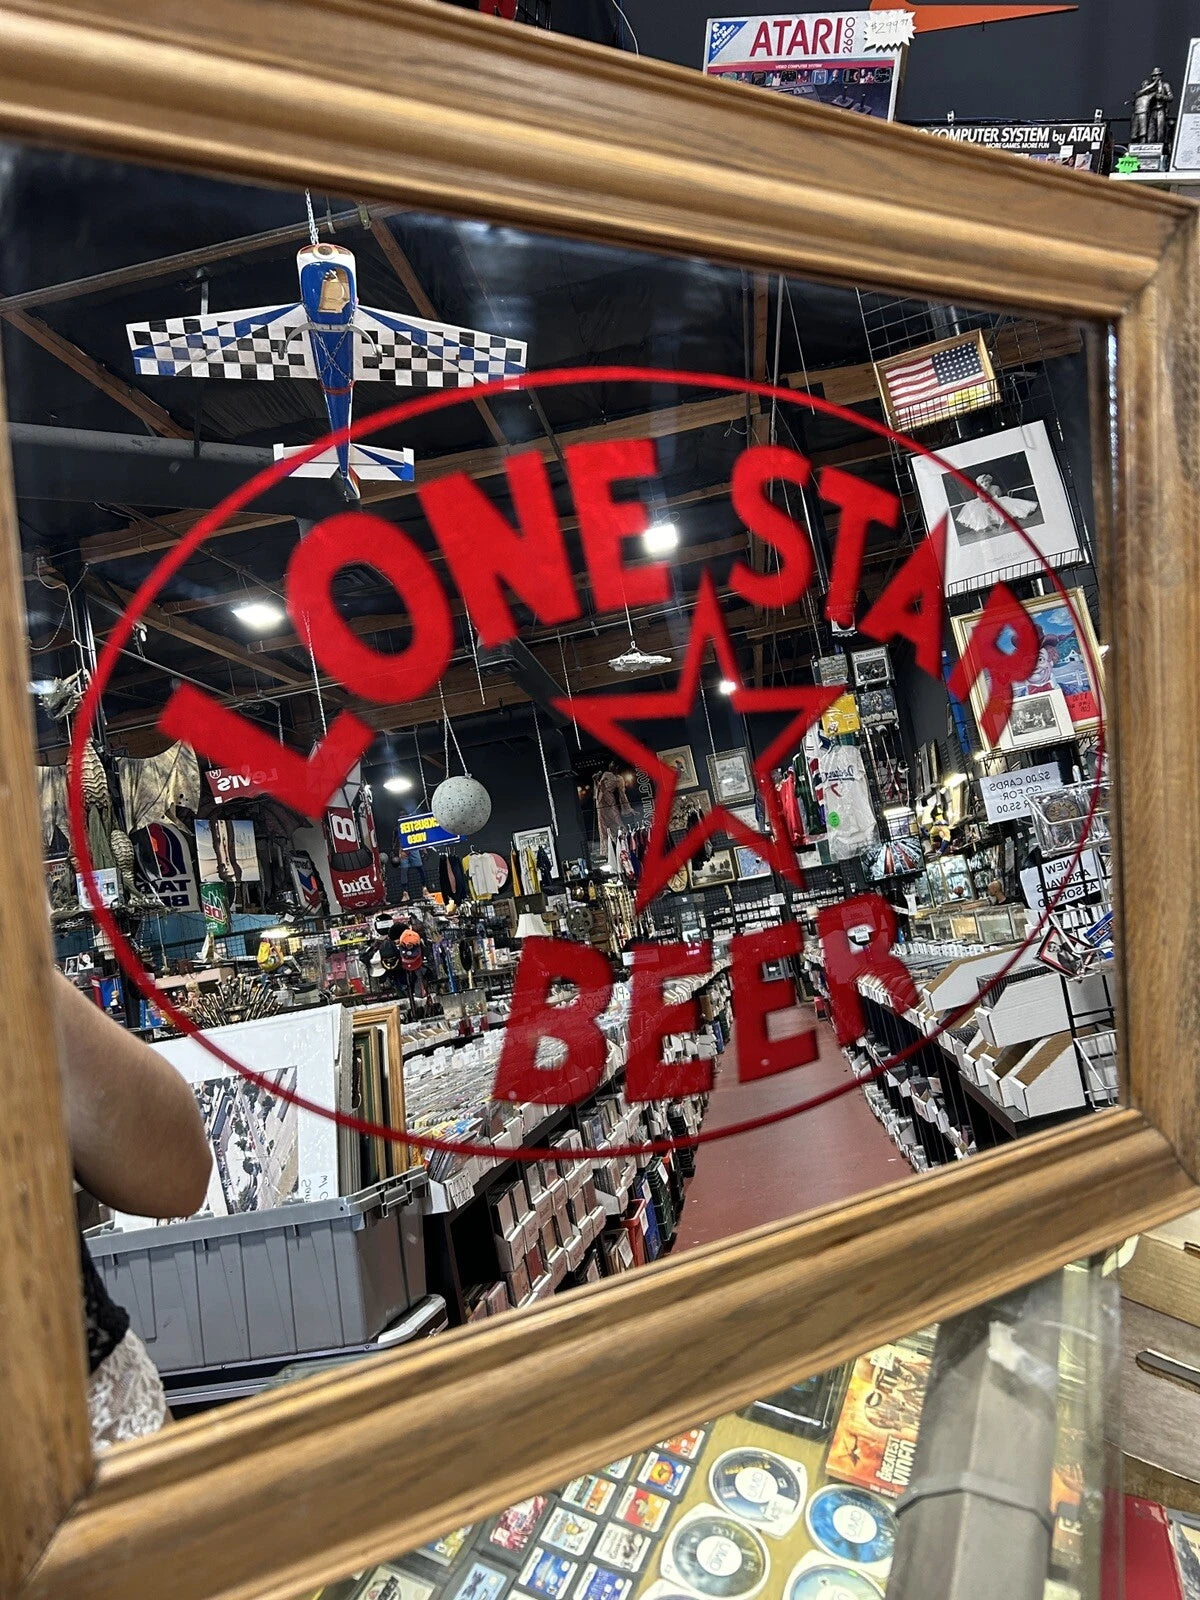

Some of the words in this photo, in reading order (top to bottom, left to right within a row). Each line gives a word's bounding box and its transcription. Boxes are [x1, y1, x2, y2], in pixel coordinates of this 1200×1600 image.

[750, 17, 843, 57] ATARI
[842, 16, 856, 54] 2600
[1001, 127, 1050, 142] SYSTEM
[1052, 129, 1066, 146] by
[1067, 126, 1105, 142] ATARI
[157, 437, 670, 819] LONE
[728, 444, 1037, 744] STAR
[494, 893, 914, 1104] BEER
[880, 1436, 902, 1485] GREATEST
